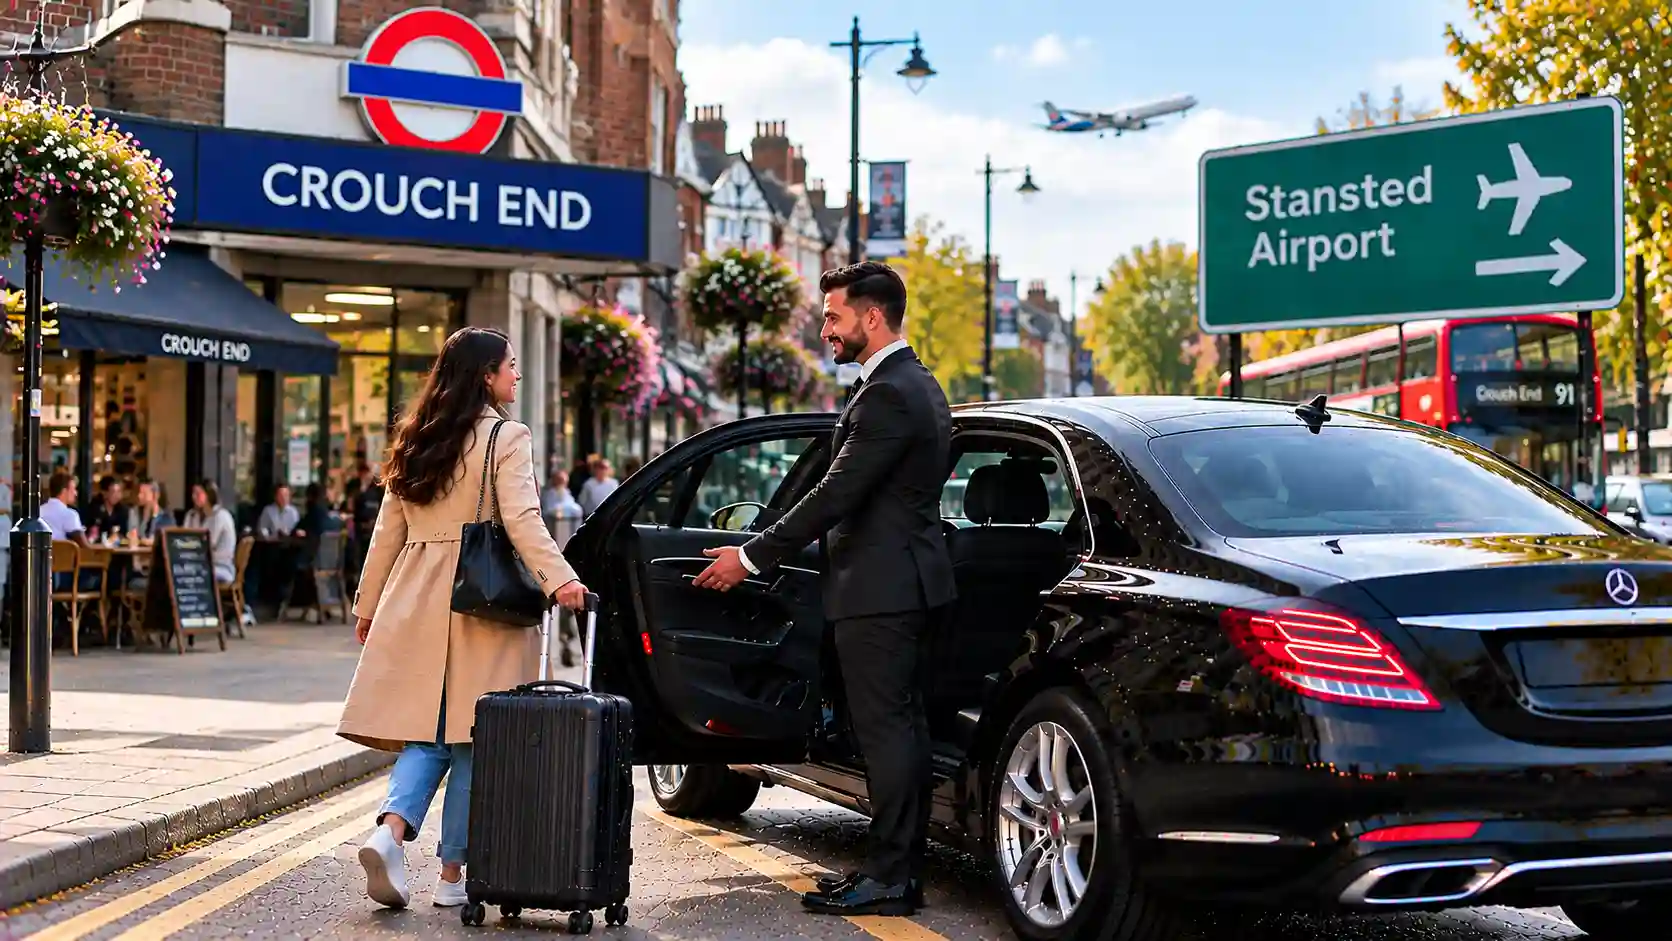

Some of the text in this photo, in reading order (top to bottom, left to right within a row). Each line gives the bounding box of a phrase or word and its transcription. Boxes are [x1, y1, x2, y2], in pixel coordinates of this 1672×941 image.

[262, 162, 592, 231] CROUCH END
[1245, 164, 1432, 221] Stansted
[1248, 222, 1396, 272] Airport
[161, 333, 251, 362] CROUCH END
[1555, 382, 1575, 405] 91
